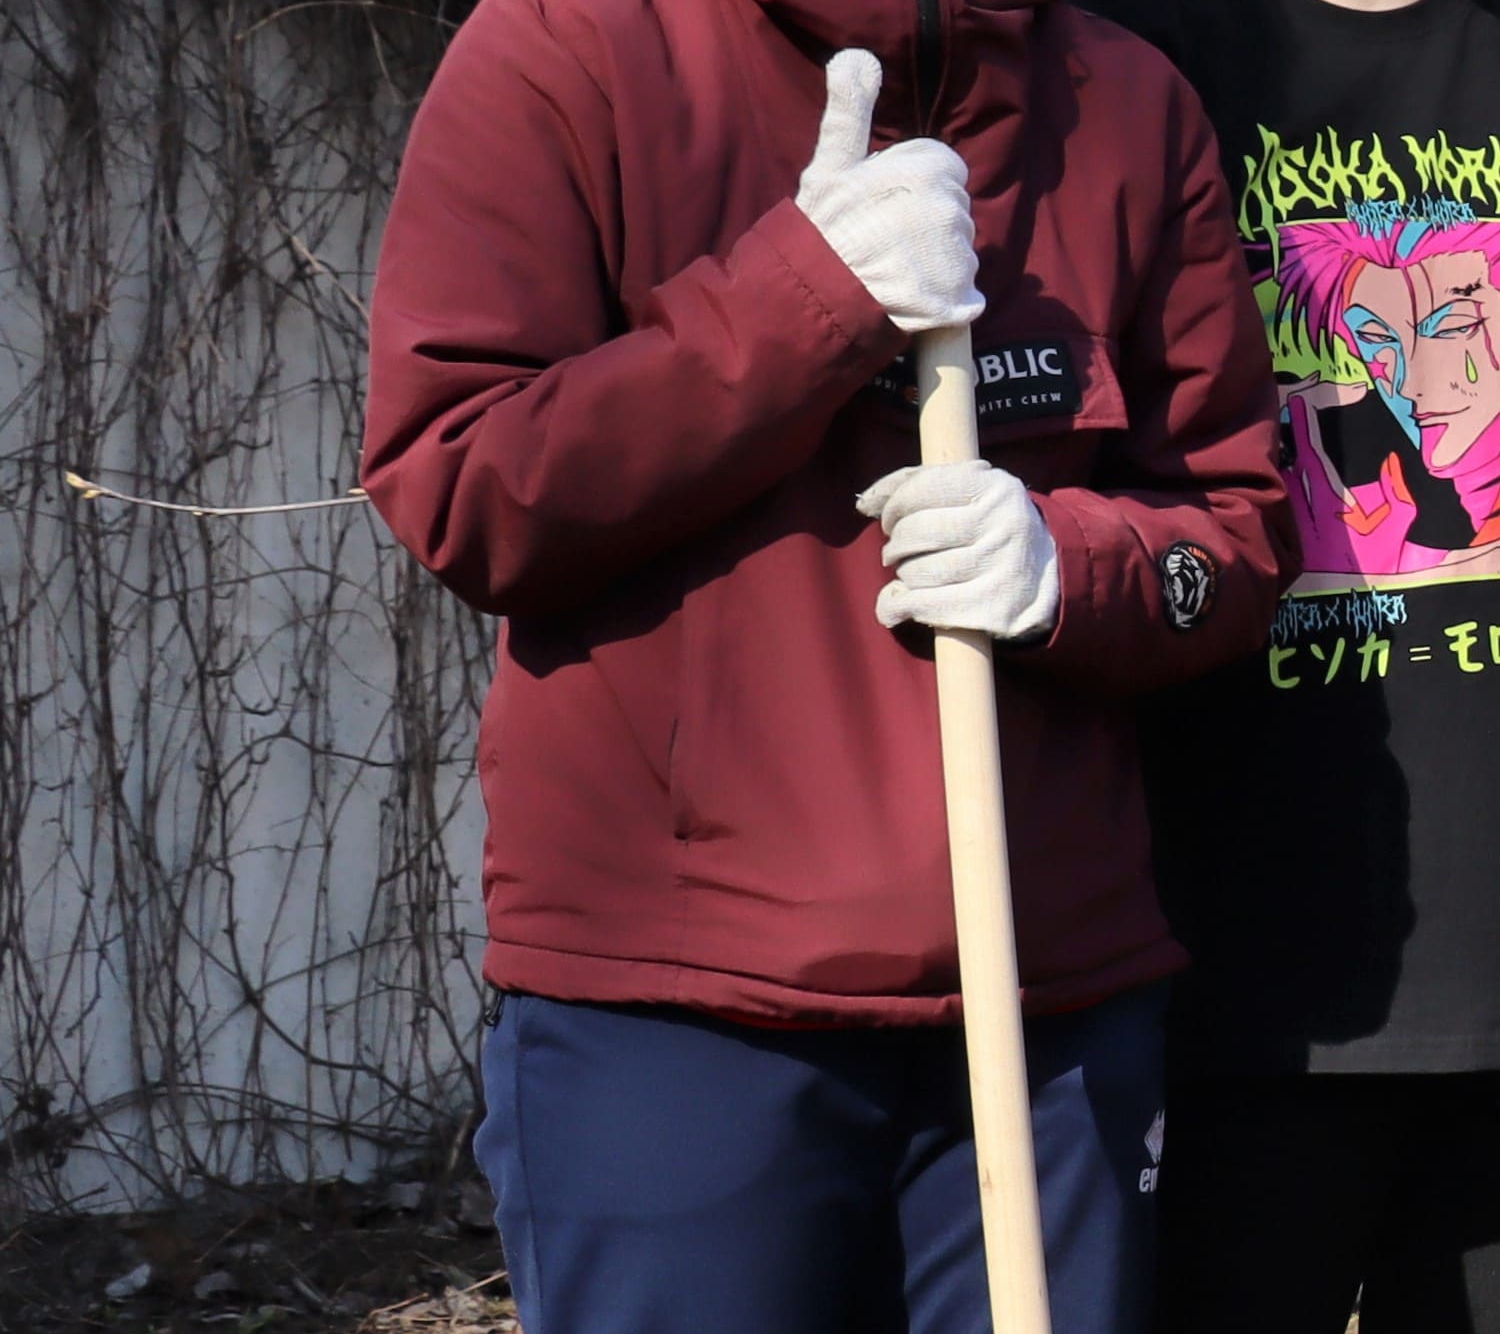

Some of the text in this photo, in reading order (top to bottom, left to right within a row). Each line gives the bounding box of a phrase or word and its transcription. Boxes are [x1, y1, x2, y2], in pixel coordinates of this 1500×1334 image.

[973, 348, 1062, 385] BLIC
[1021, 392, 1062, 405] CREW
[1269, 594, 1322, 645] UNTER
